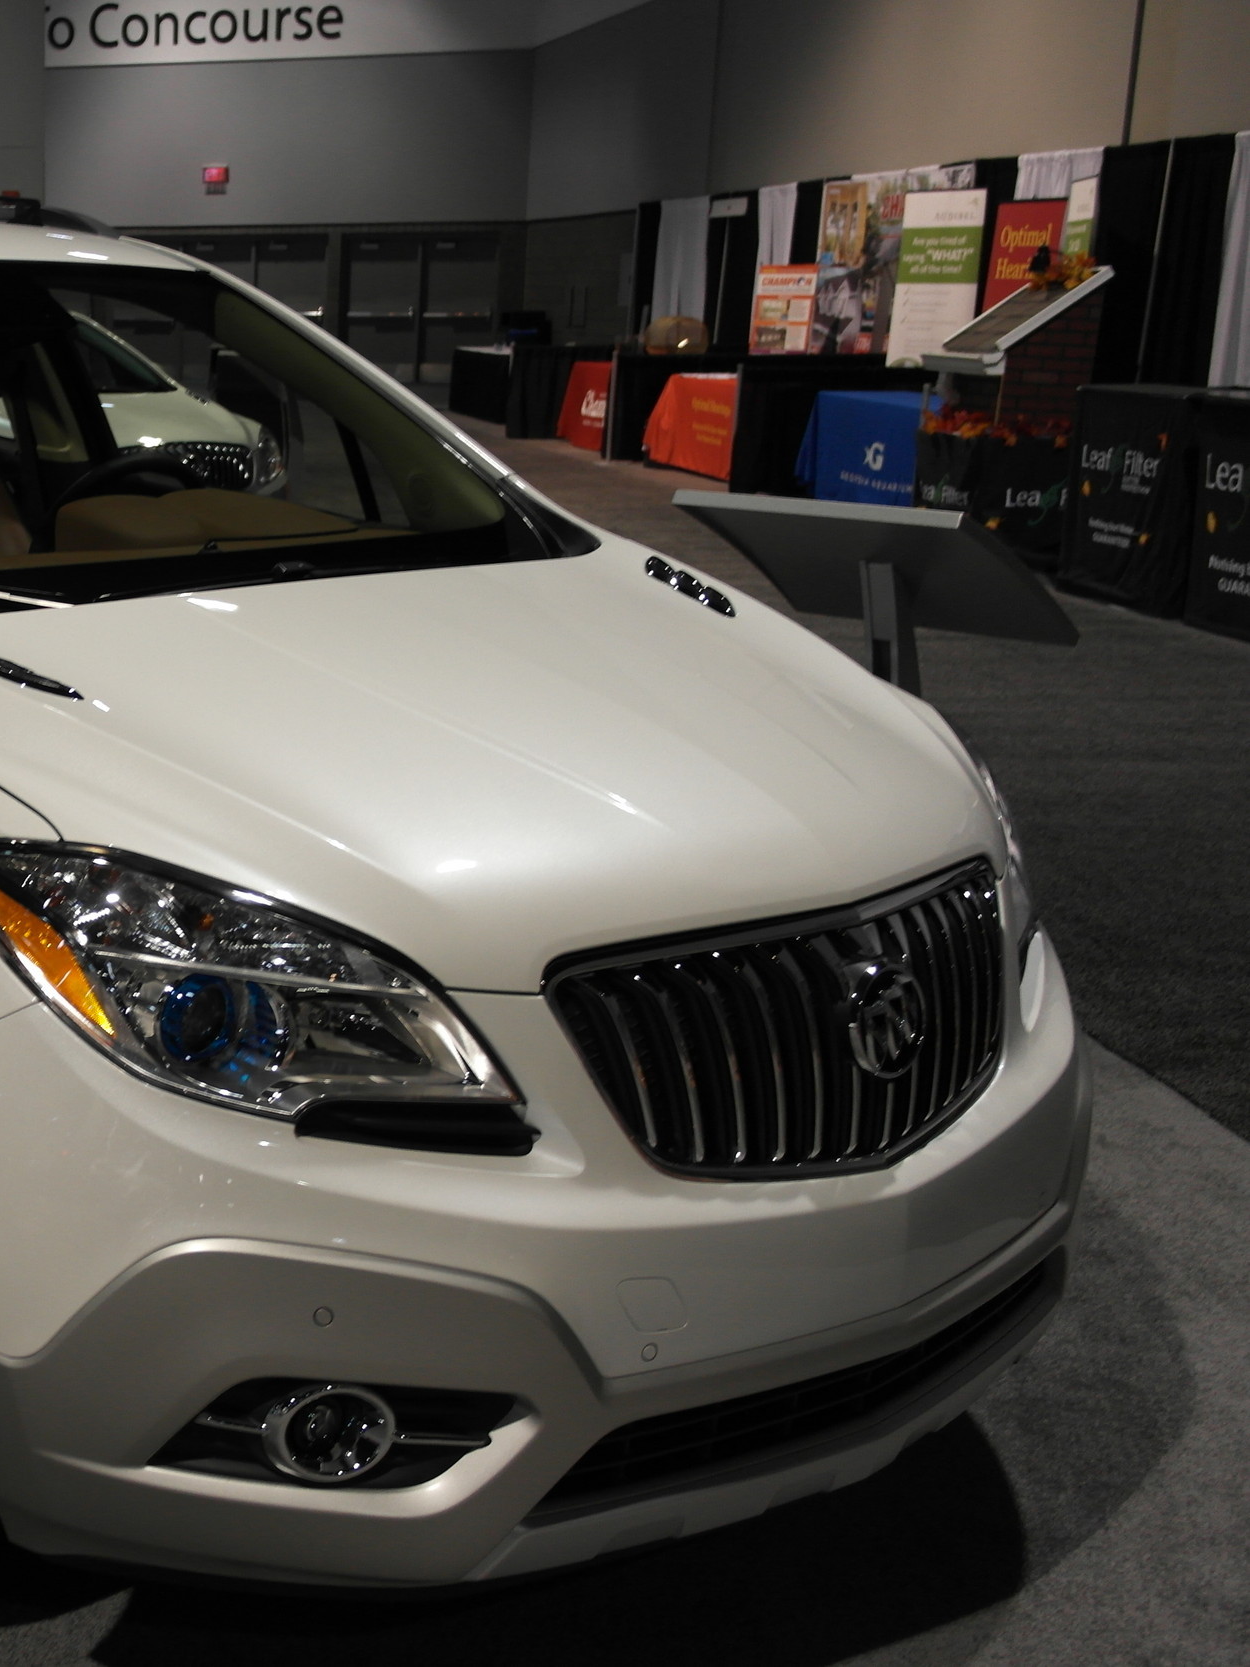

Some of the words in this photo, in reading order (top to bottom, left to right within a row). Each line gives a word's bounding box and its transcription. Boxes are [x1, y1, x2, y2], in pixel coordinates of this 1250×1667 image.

[88, 3, 344, 48] Concourse
[925, 237, 938, 248] you
[1000, 223, 1053, 253] Optimal
[1123, 449, 1161, 478] Filter
